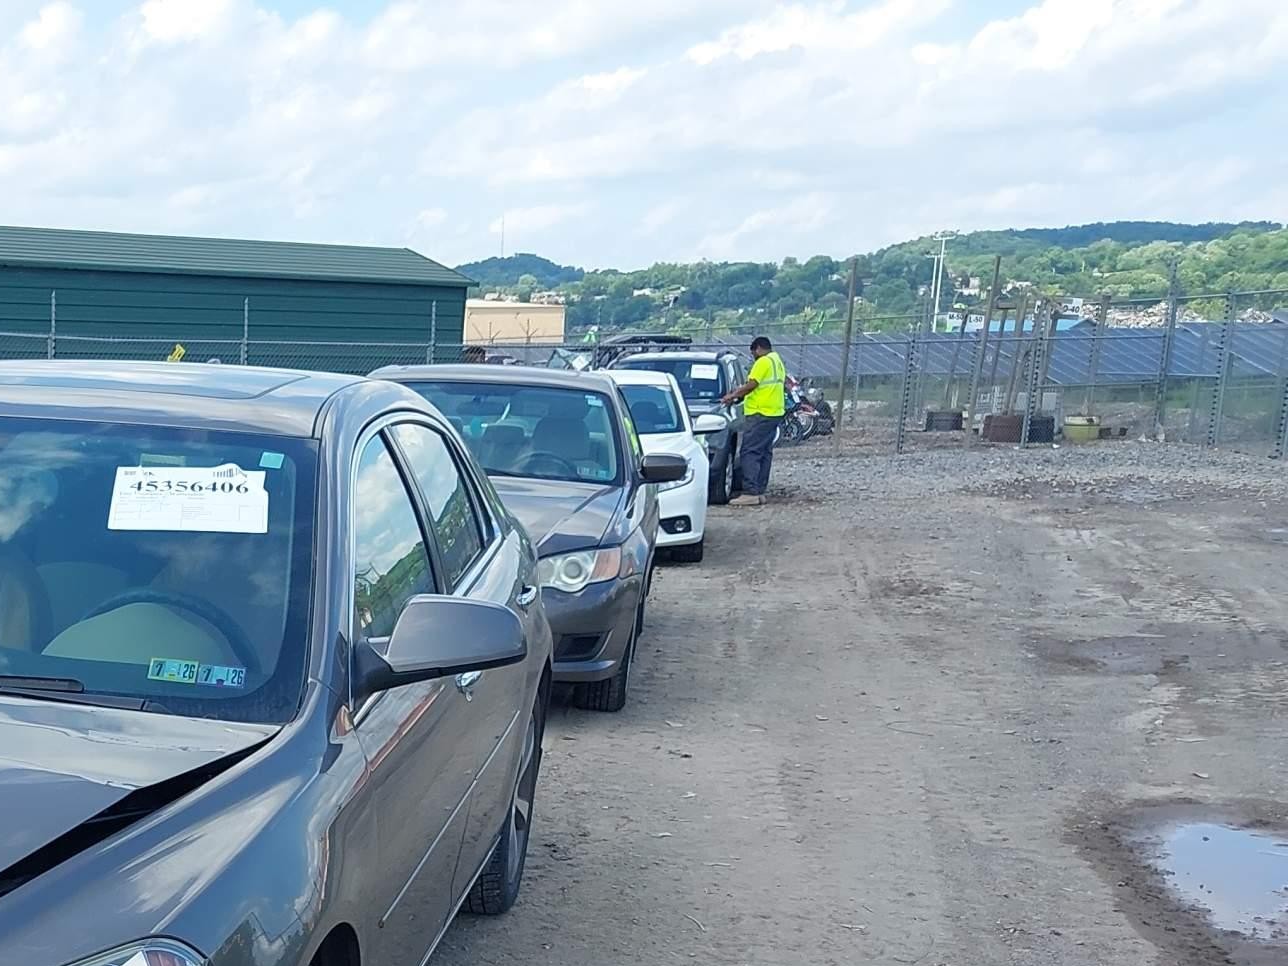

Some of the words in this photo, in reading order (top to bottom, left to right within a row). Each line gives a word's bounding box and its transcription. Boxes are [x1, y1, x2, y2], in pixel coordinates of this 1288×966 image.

[968, 315, 983, 323] L-50
[129, 480, 249, 494] 45356406
[182, 663, 195, 680] 26
[231, 669, 243, 685] 26
